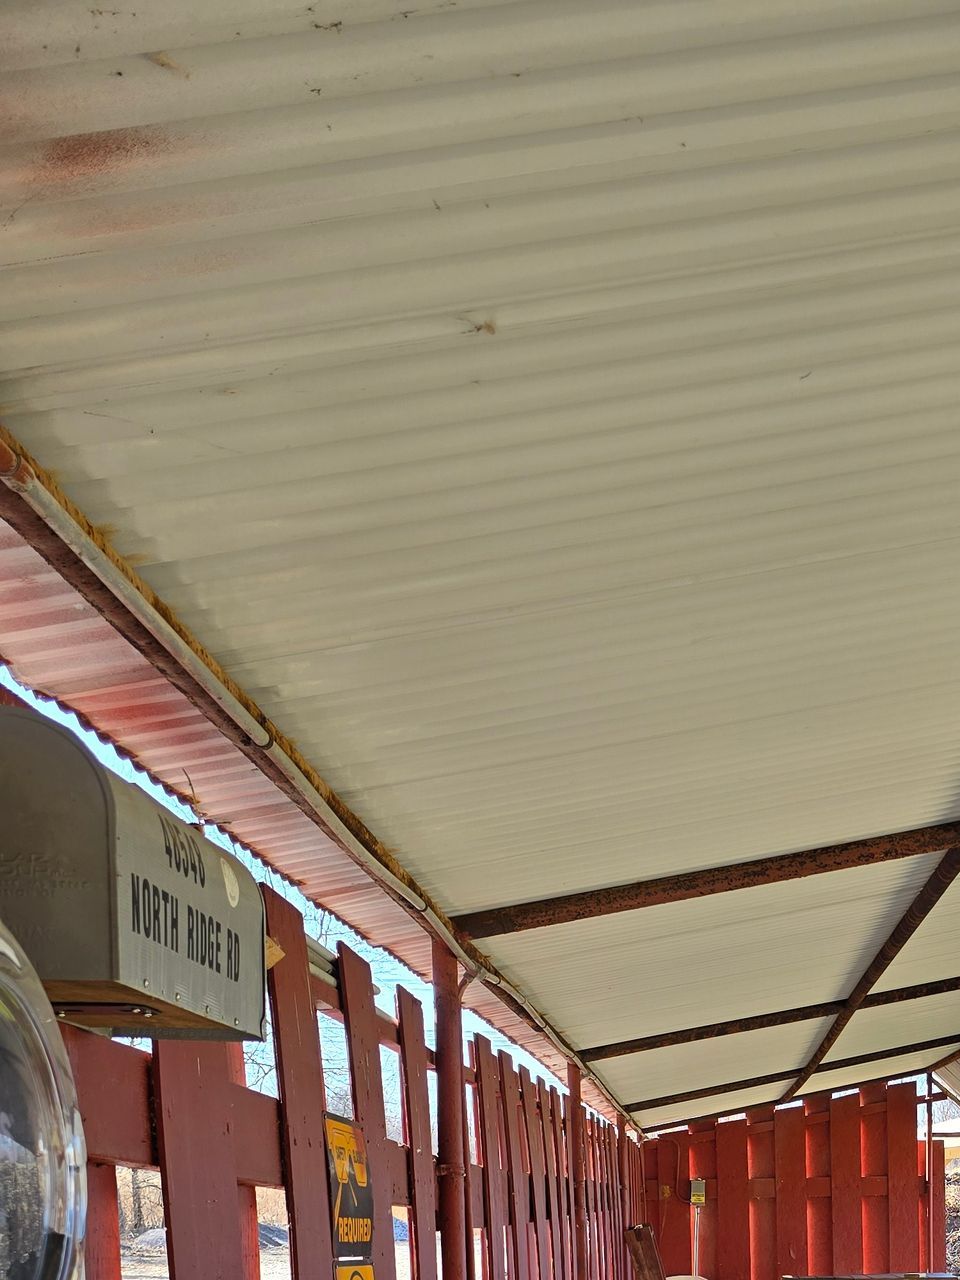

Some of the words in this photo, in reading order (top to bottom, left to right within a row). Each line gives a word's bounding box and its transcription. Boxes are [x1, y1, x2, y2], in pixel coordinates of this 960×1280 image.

[131, 872, 179, 953] NORTH
[187, 904, 222, 974] RIDGE
[226, 928, 240, 982] RD
[338, 1217, 372, 1242] REQUIRED
